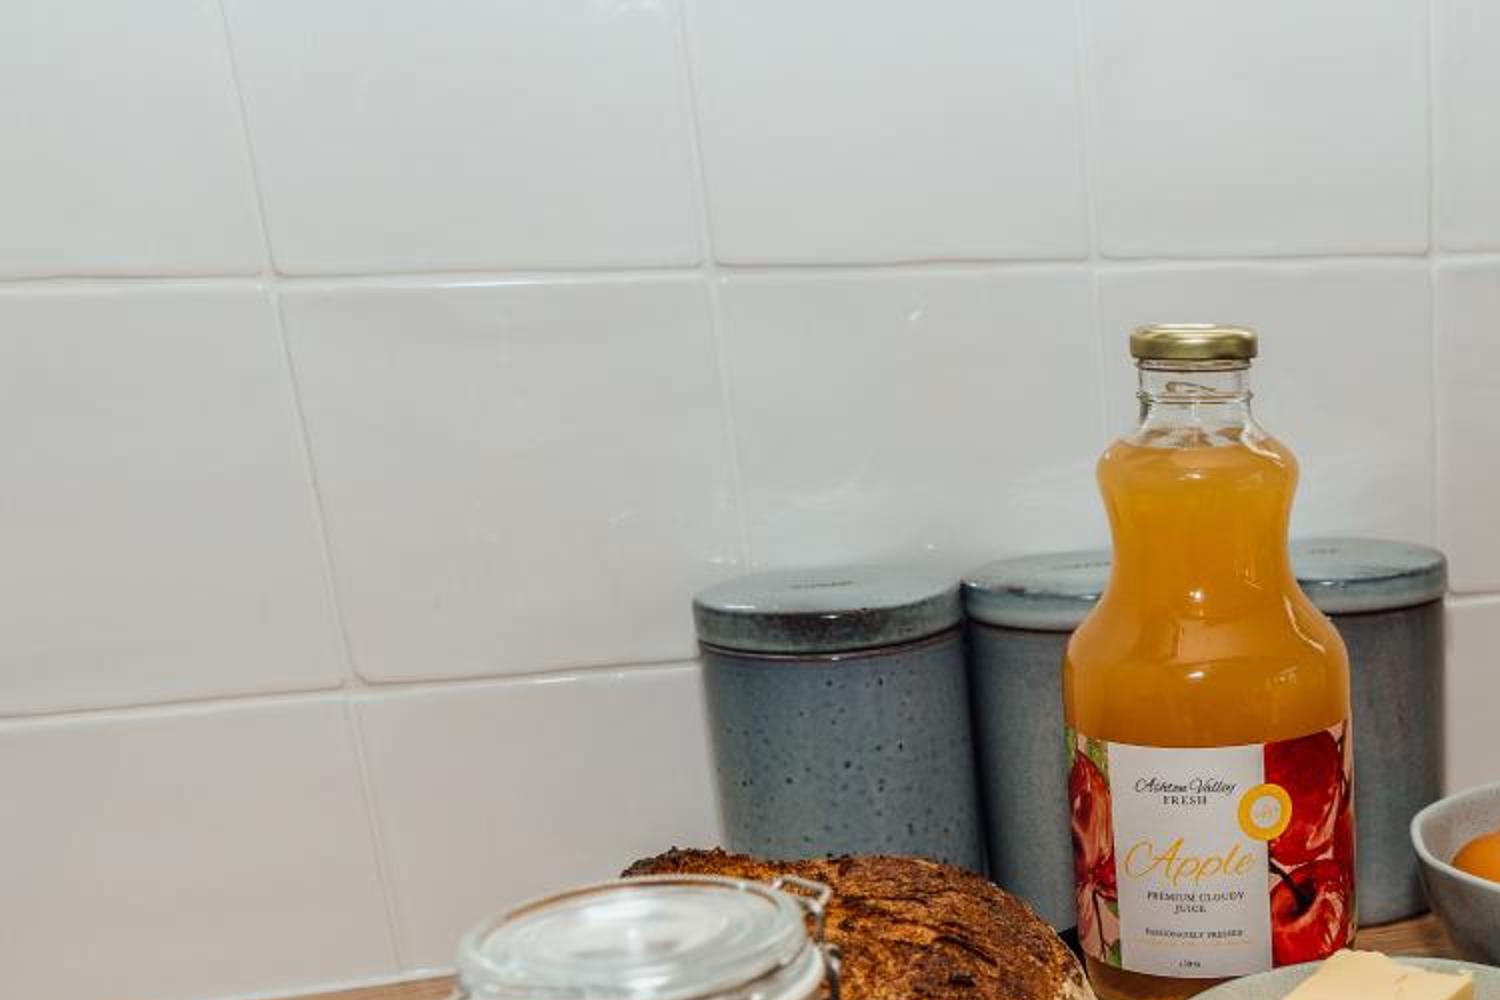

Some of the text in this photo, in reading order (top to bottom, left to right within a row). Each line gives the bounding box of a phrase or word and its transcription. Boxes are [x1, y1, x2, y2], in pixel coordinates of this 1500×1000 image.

[1134, 777, 1239, 796] Ashton Valley
[1162, 795, 1207, 806] FRESH
[1121, 836, 1258, 887] Apple
[1147, 890, 1196, 902] PREMIUM
[1173, 904, 1207, 915] JUICE
